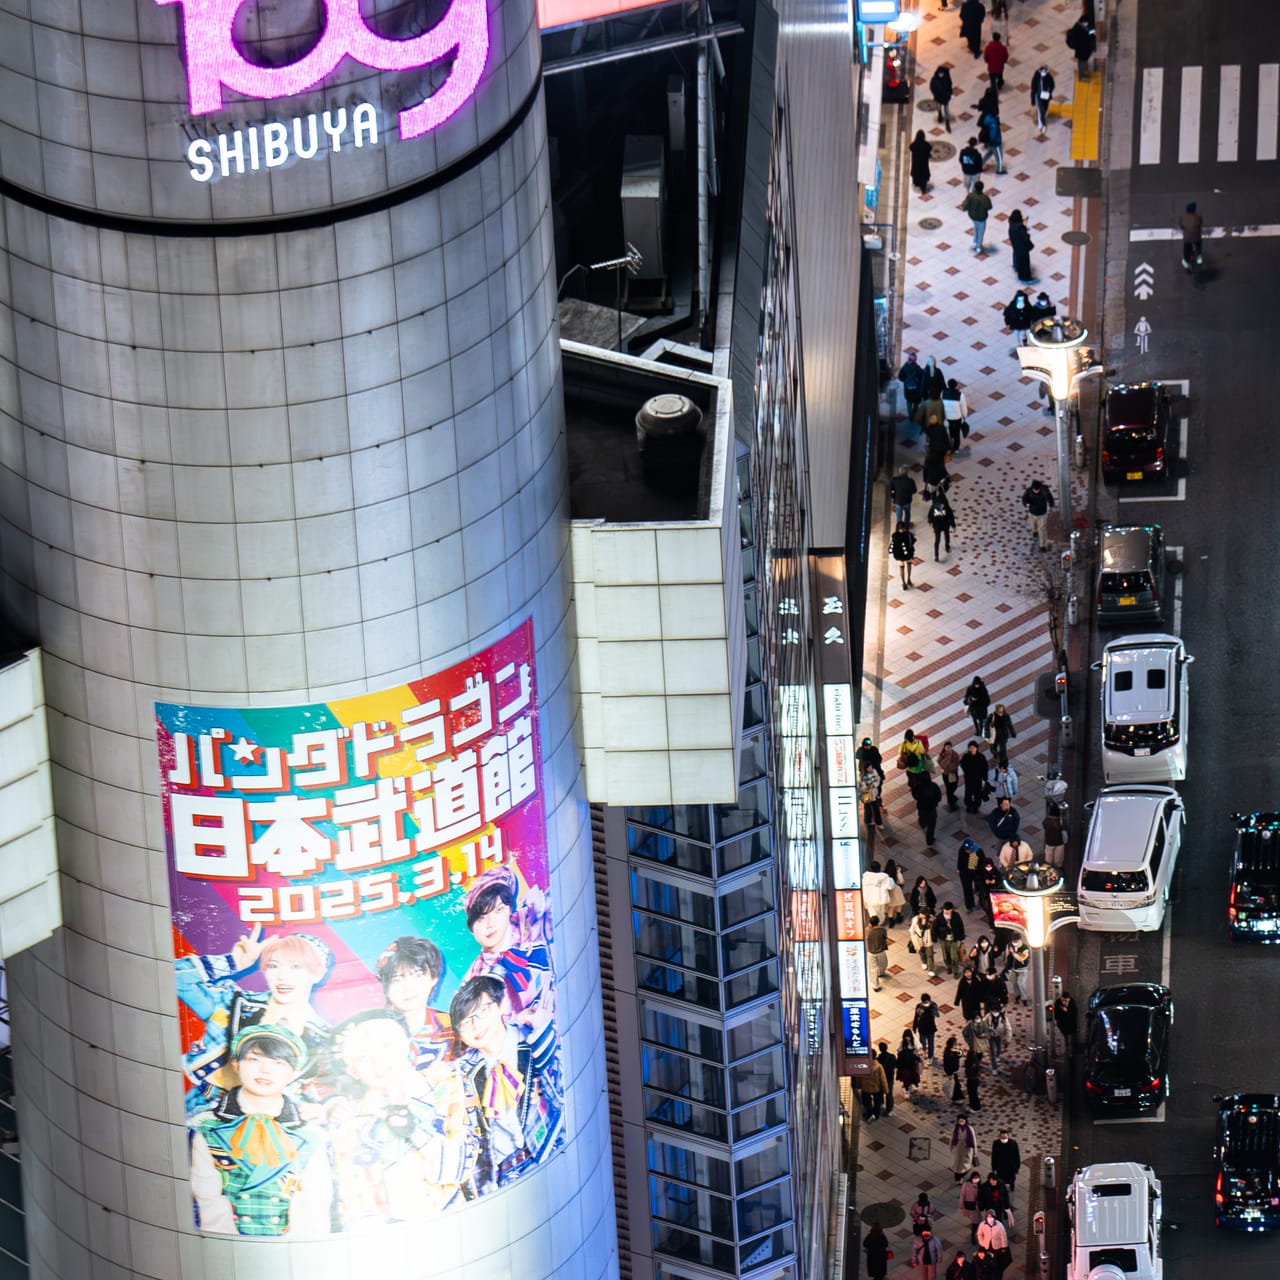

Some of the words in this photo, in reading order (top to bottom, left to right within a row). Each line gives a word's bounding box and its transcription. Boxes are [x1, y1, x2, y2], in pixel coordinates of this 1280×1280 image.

[187, 101, 379, 182] SHIBUYA
[170, 661, 534, 790] パンダドラゴン
[172, 715, 538, 878] 日本武道館
[238, 829, 509, 924] 2025.3.14
